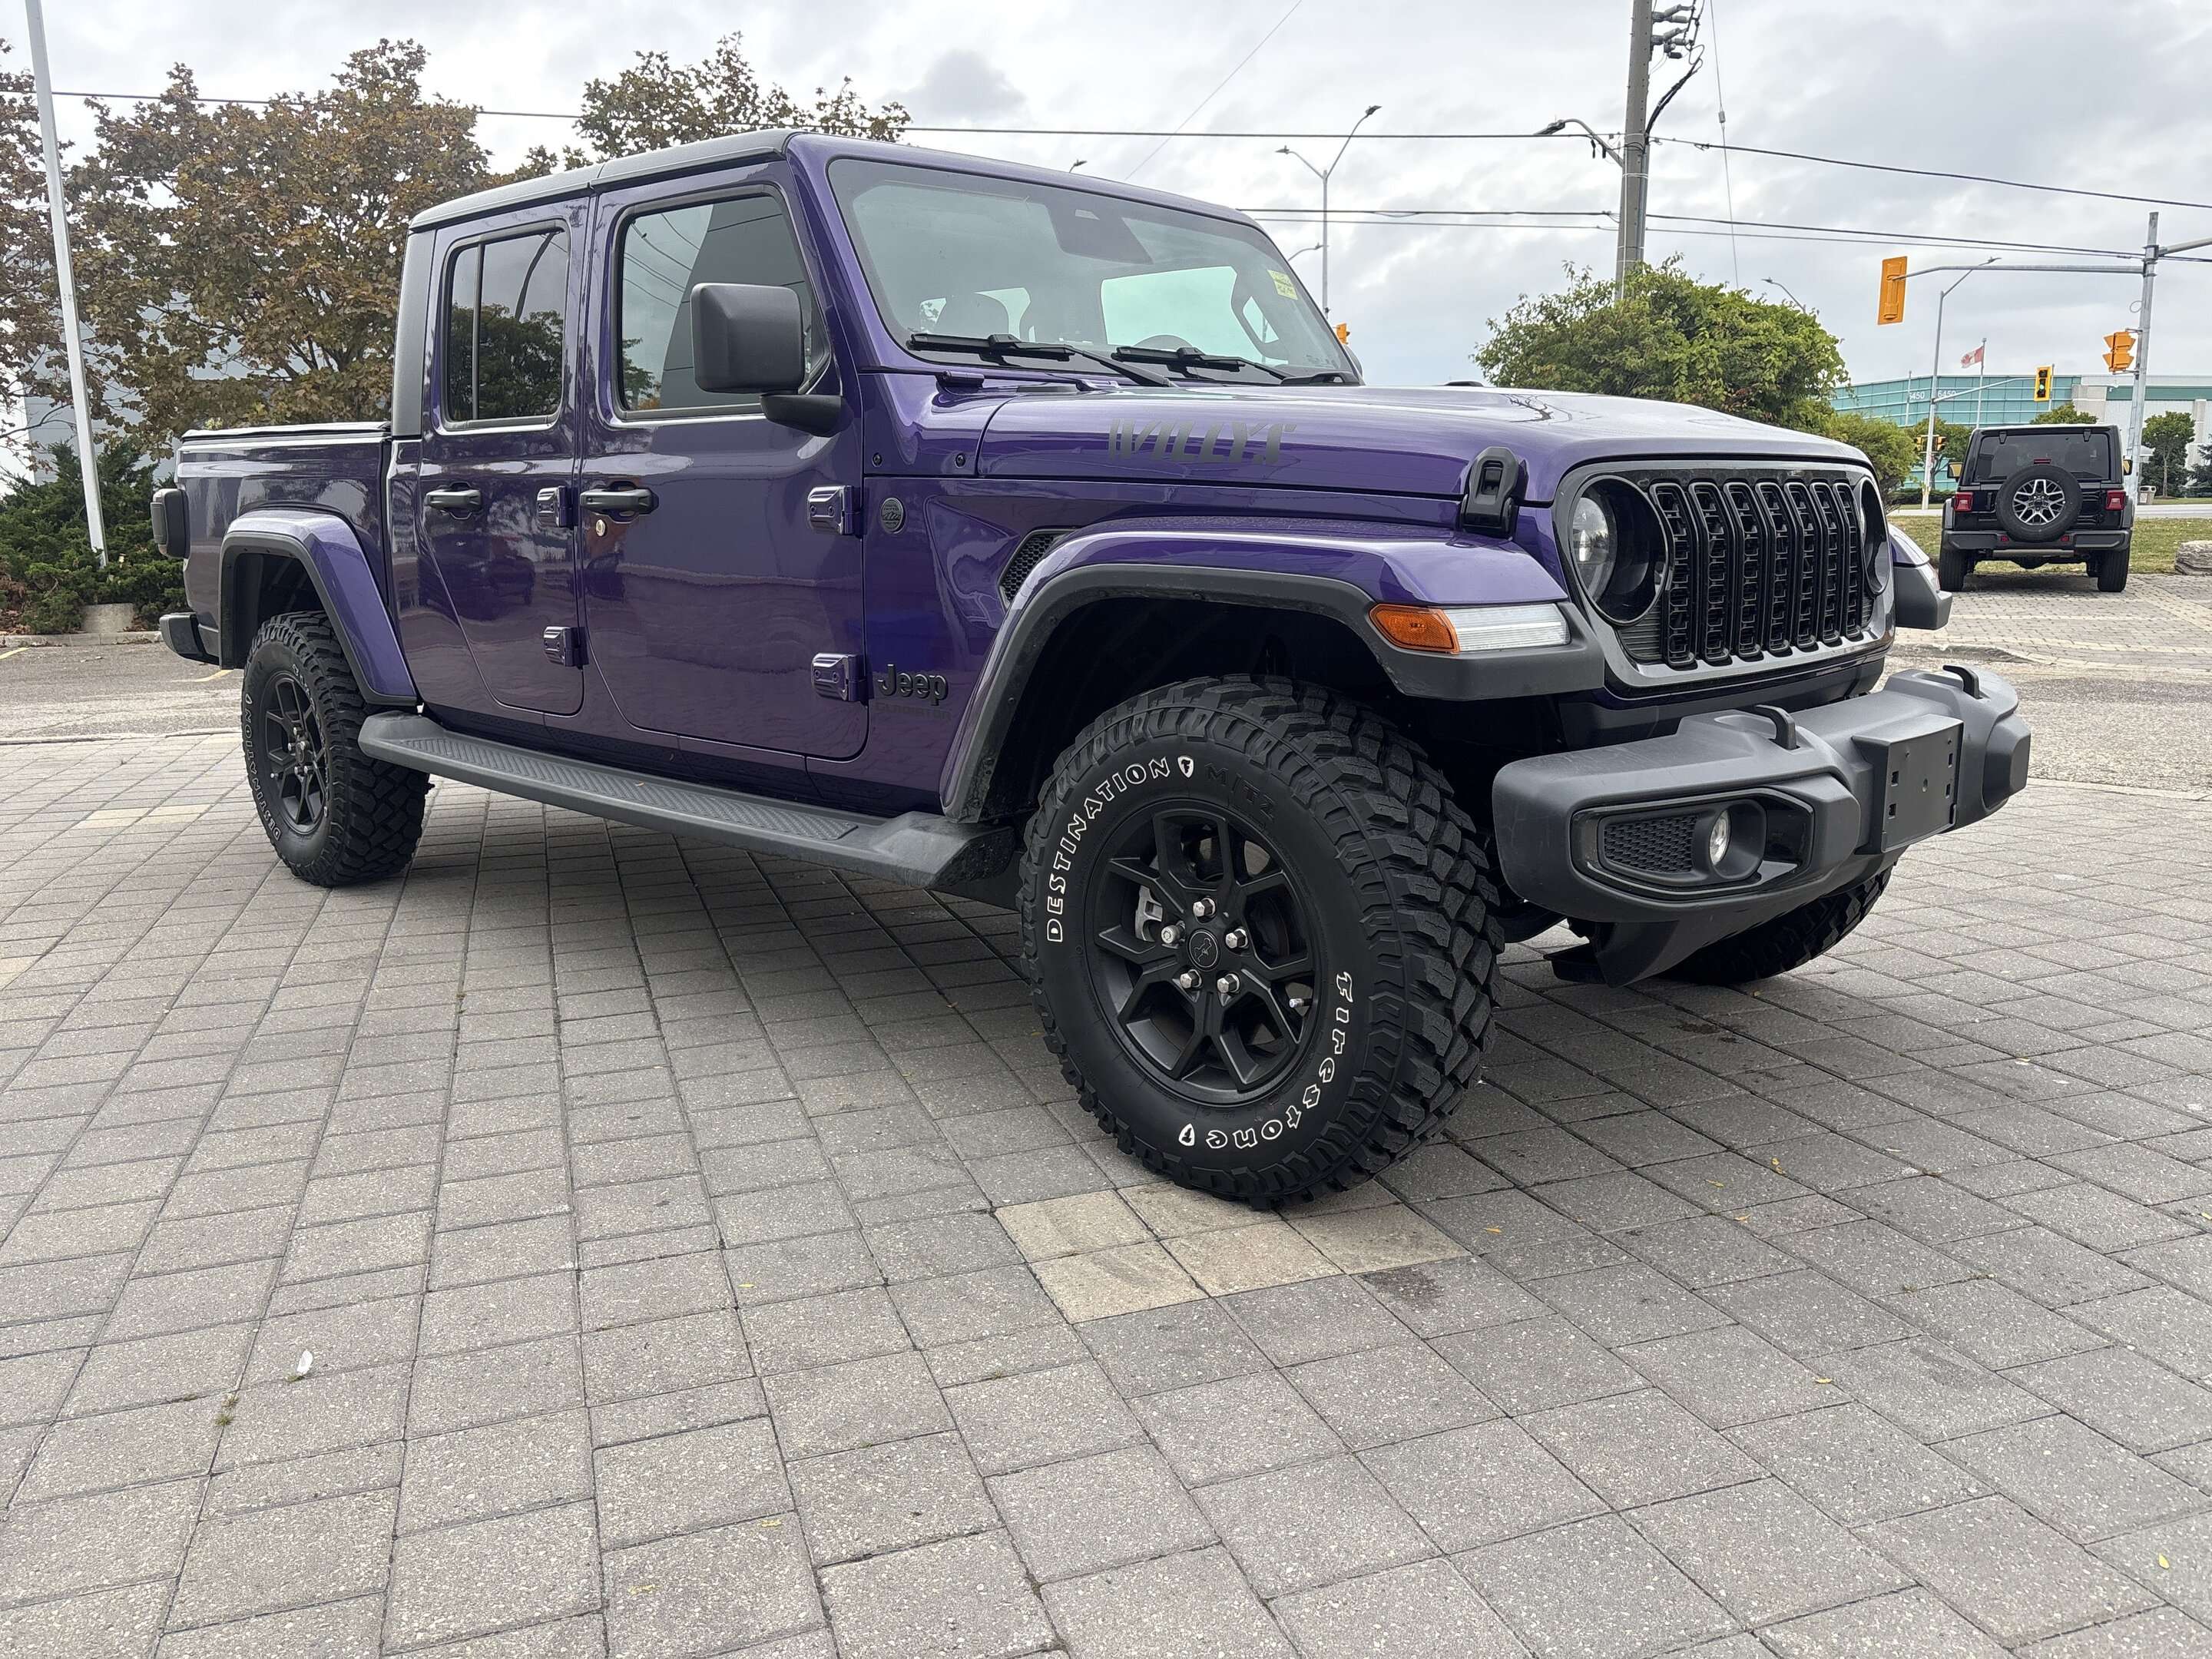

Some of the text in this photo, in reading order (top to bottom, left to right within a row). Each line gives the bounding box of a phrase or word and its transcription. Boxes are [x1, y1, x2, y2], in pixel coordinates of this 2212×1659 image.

[1108, 419, 1297, 463] WILLYS
[876, 663, 949, 707] Jeep
[245, 708, 282, 841] DESTINATION
[1047, 757, 1171, 942] DESTINATION
[1206, 971, 1353, 1149] Firestone
